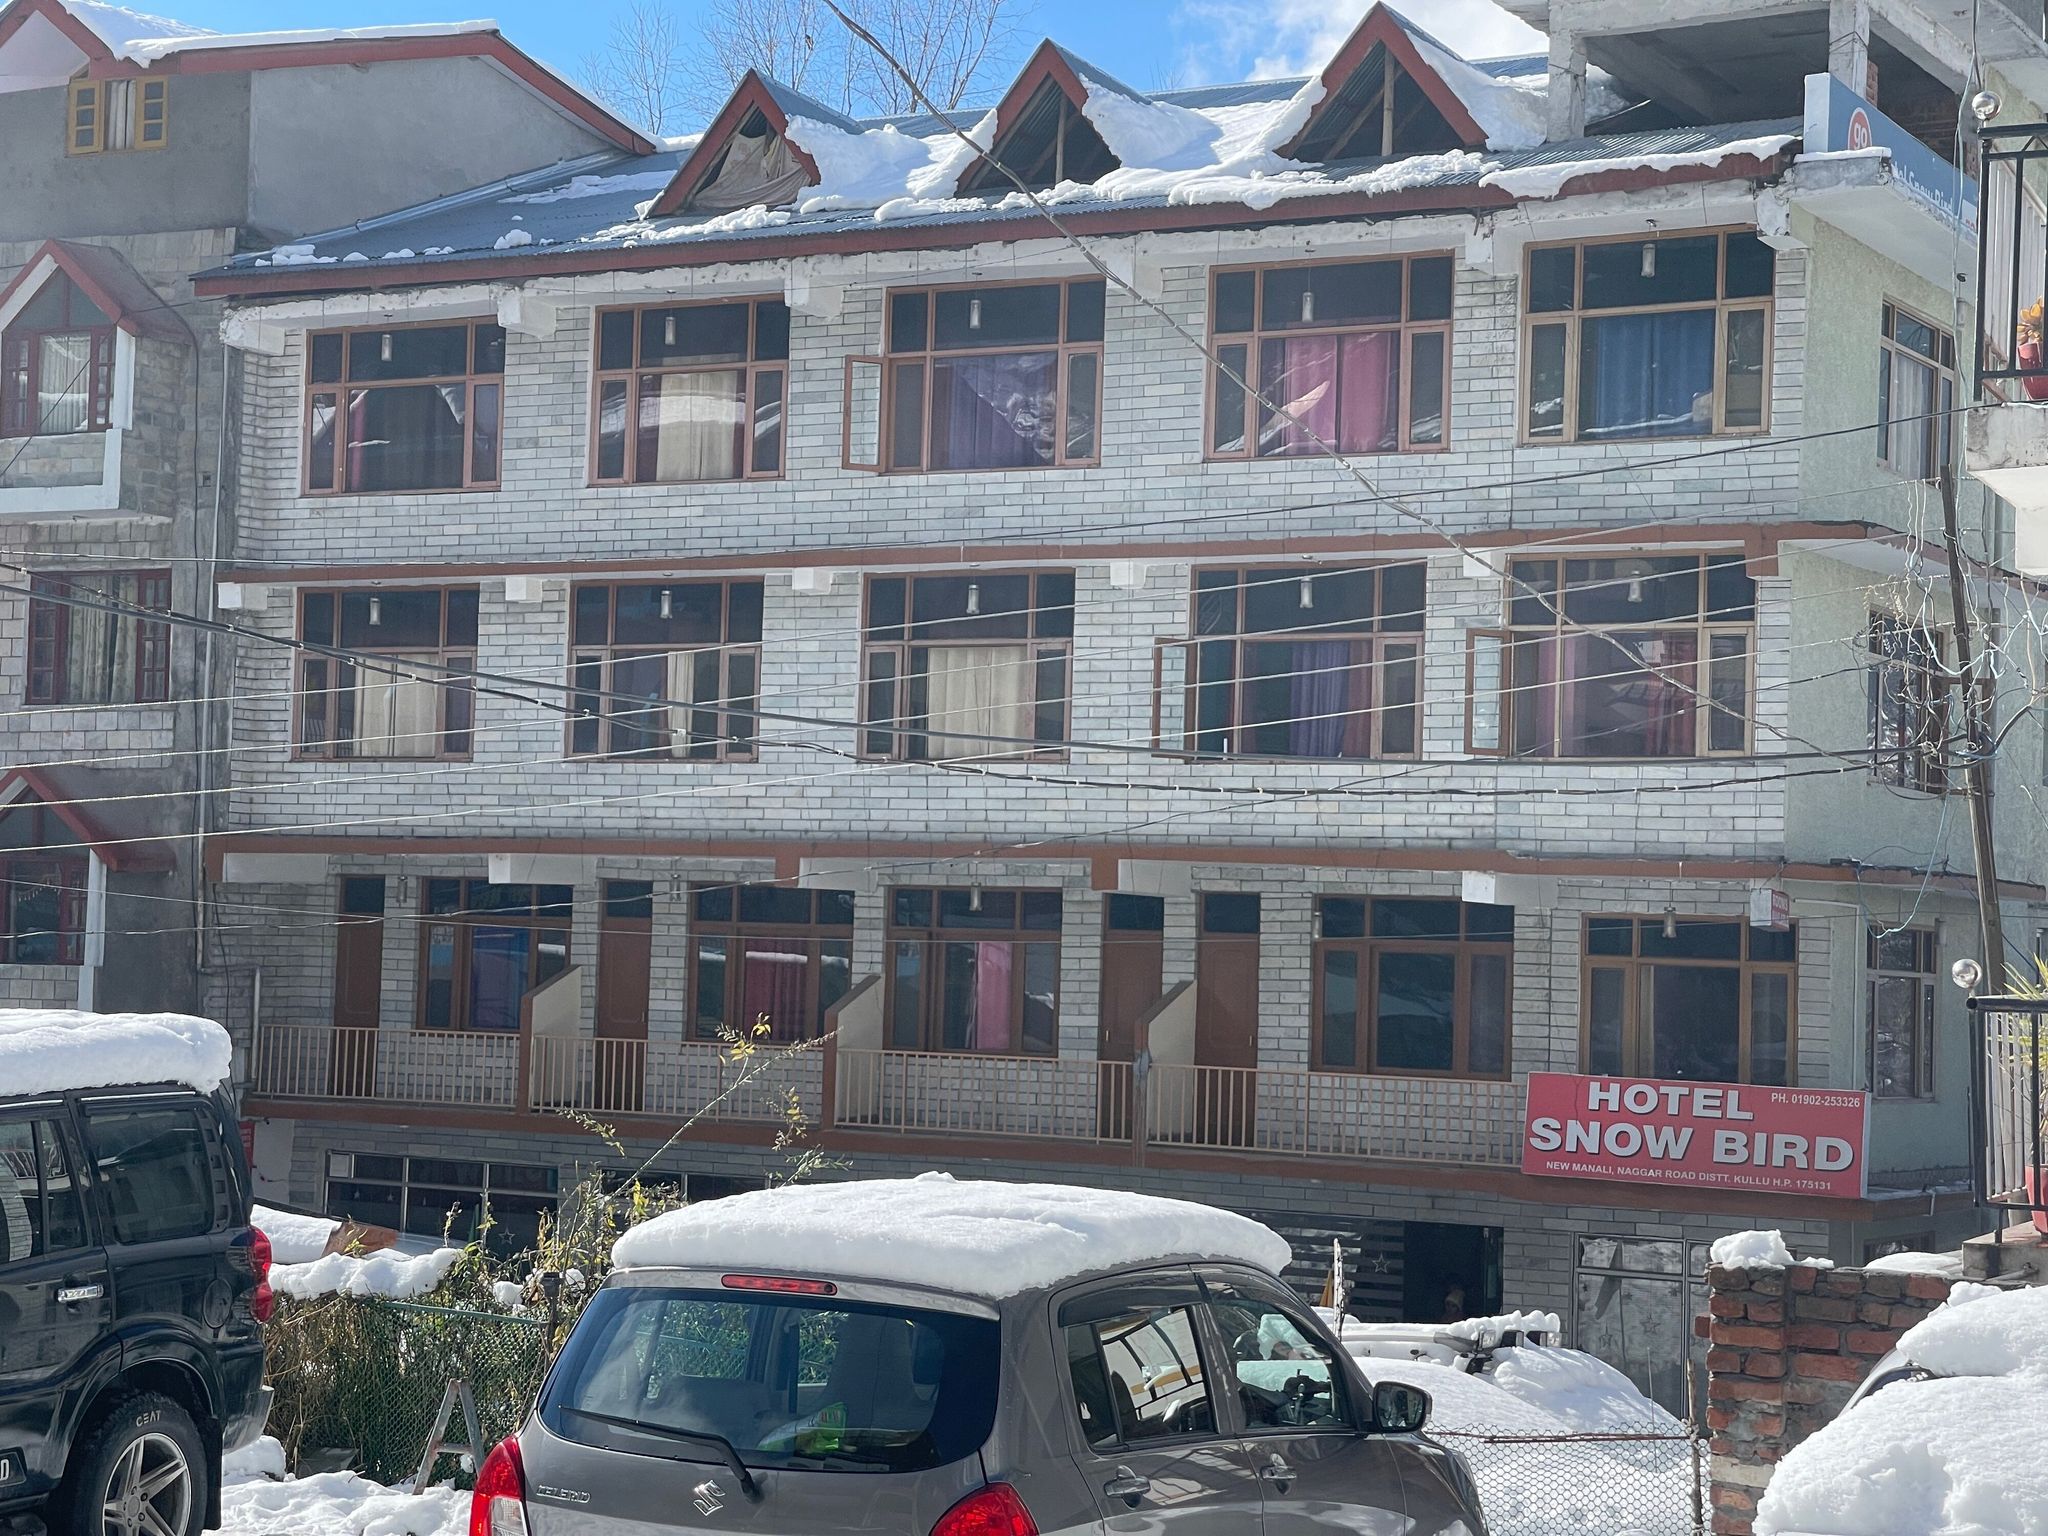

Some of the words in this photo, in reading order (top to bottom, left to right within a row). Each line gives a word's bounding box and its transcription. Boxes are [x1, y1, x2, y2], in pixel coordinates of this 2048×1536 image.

[1588, 1081, 1754, 1120] HOTEL
[1771, 1092, 1789, 1104] PH.
[1791, 1094, 1860, 1108] 01902-253326
[1529, 1117, 1694, 1160] SNOW
[1712, 1129, 1854, 1171] BIRD
[1546, 1161, 1570, 1171] NEW
[1572, 1163, 1614, 1175] MANALI,
[1617, 1166, 1662, 1178] NAGGAR
[1665, 1170, 1696, 1180] ROAD
[1699, 1172, 1731, 1183] DISTT.
[1734, 1175, 1770, 1186] KULLU
[1772, 1178, 1793, 1188] H.P.
[1796, 1180, 1831, 1190] 175131
[136, 1410, 162, 1427] CEAT
[536, 1484, 592, 1503] CELERIO
